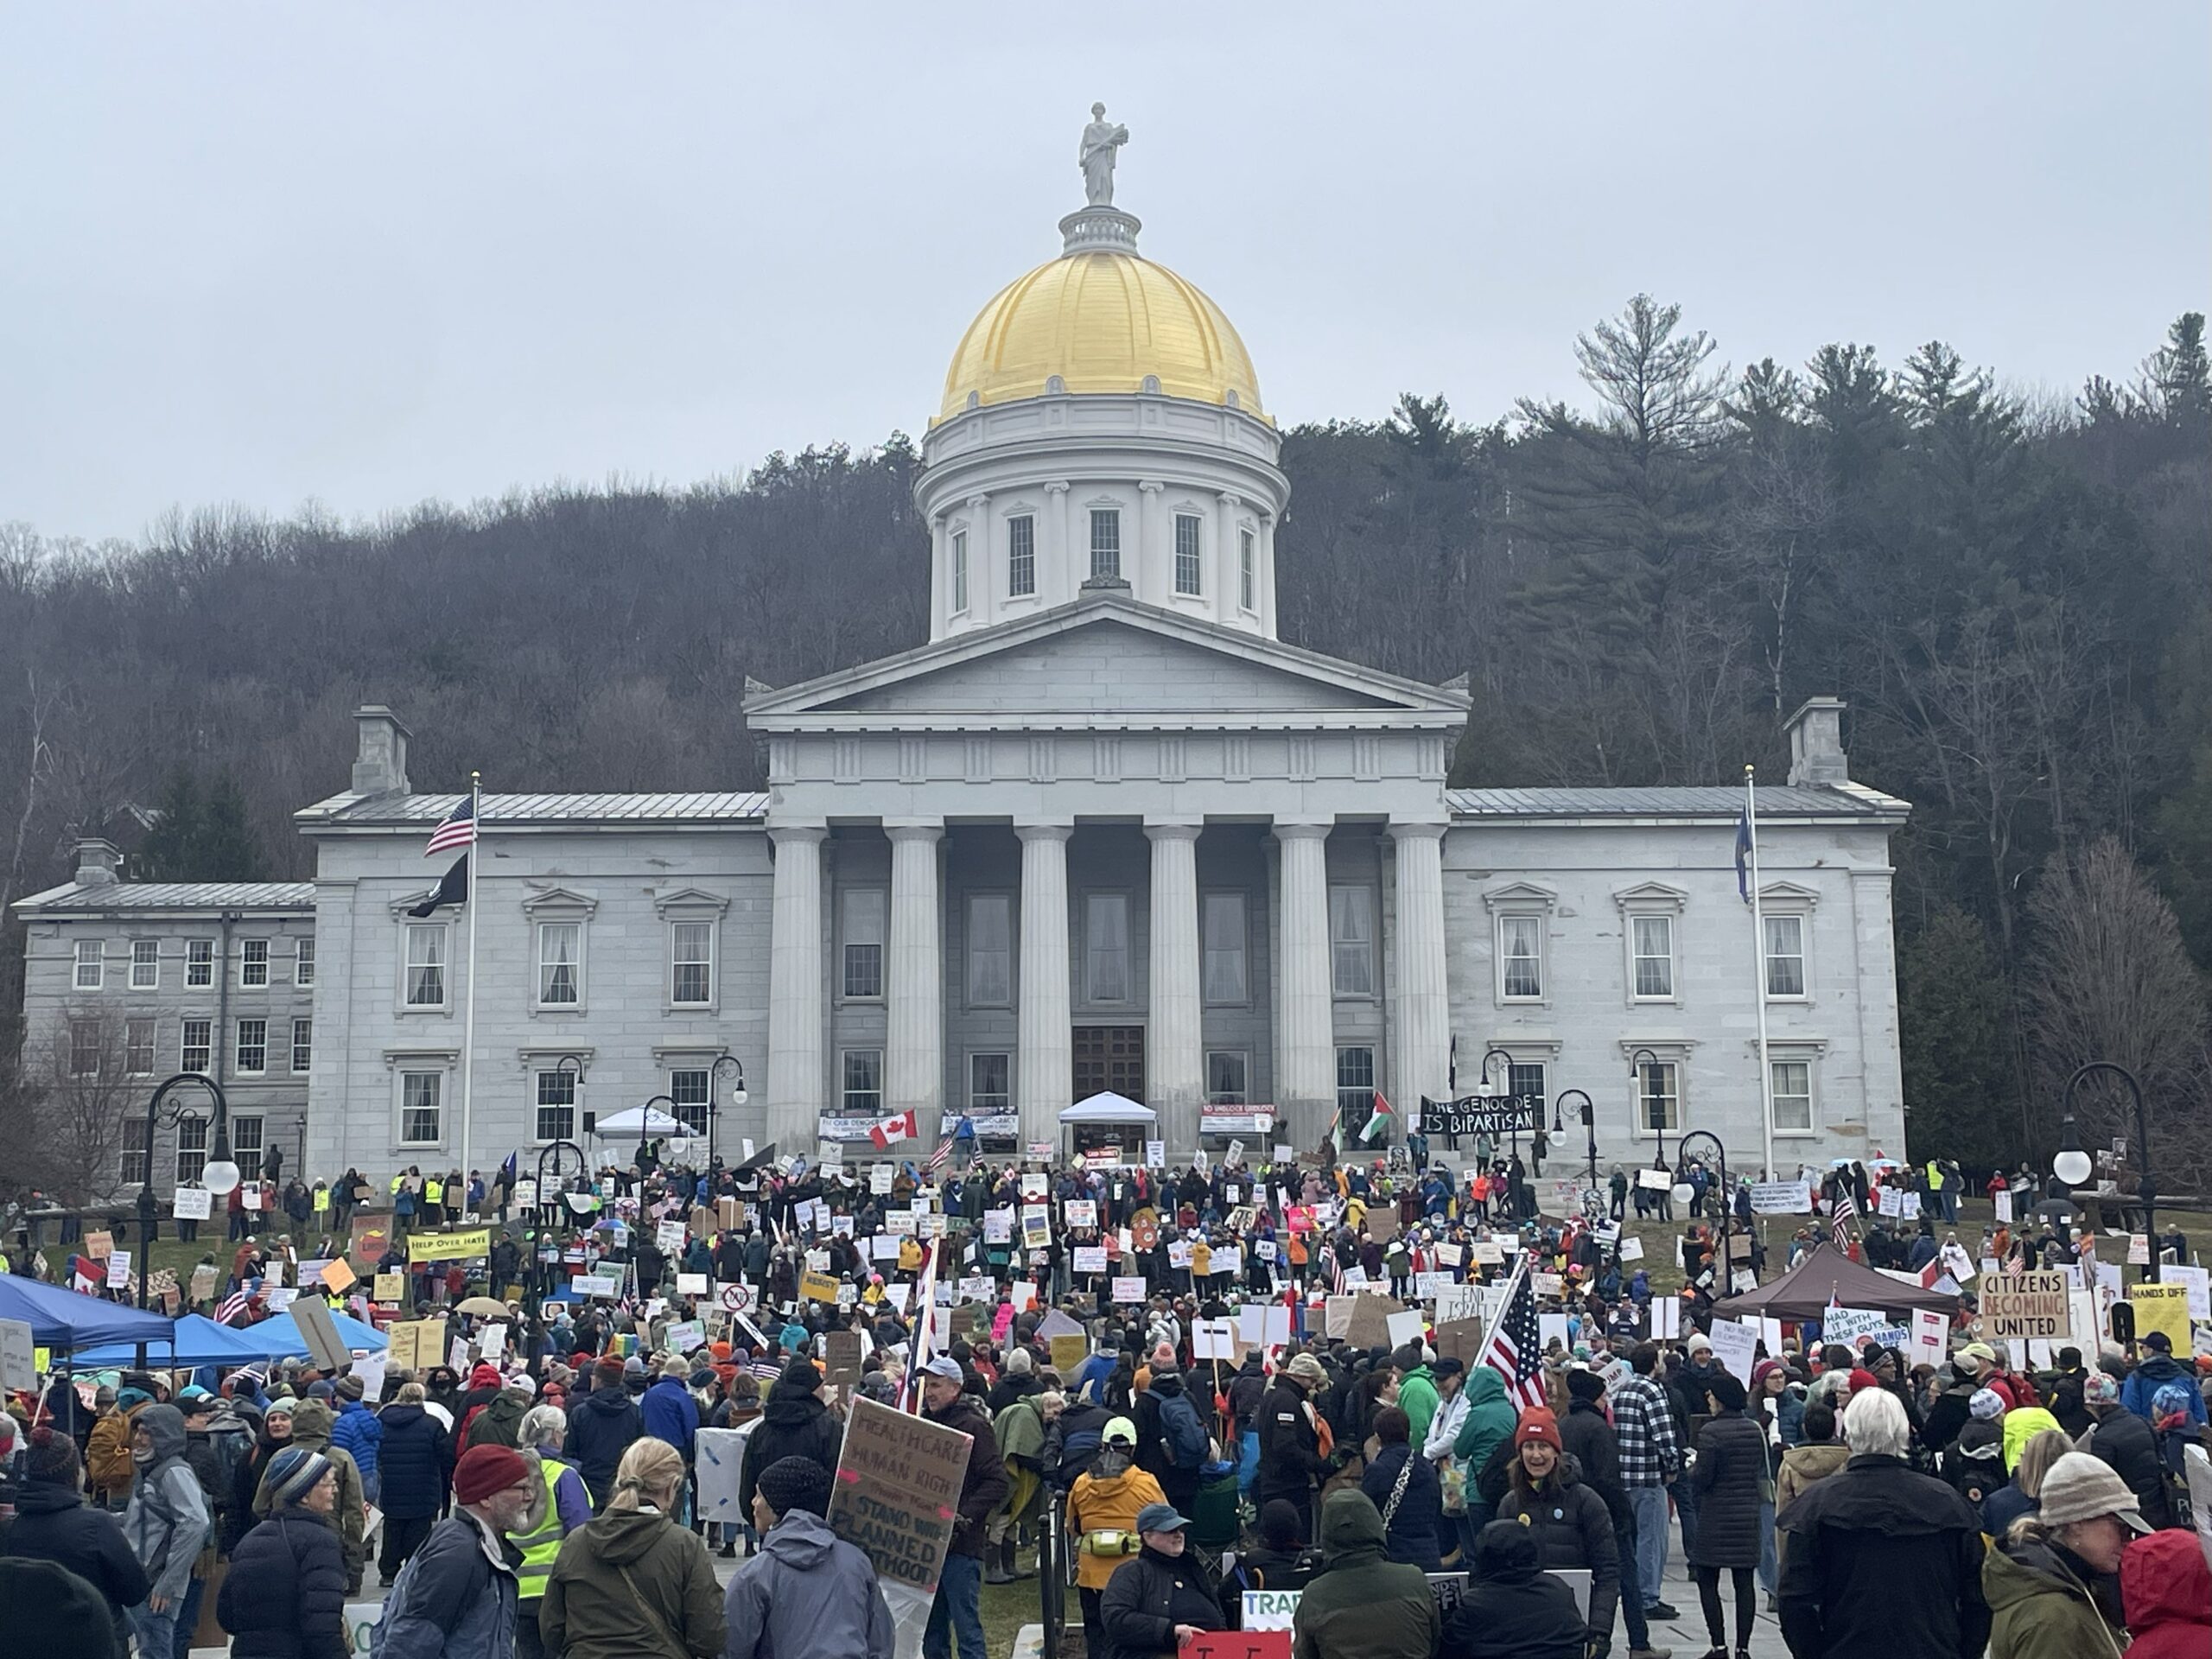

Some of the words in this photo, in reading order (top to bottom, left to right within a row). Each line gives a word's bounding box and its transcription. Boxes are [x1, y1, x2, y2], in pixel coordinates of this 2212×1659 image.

[1428, 1102, 1455, 1114] THE
[1459, 1094, 1532, 1114] GENOCDE
[1424, 1114, 1444, 1131] IS
[411, 1240, 434, 1249] HELP
[436, 1239, 461, 1248] OVER
[464, 1236, 486, 1245] HATE
[1986, 1274, 2062, 1294] CITIZENS
[2133, 1288, 2164, 1299] HANDS
[2167, 1287, 2189, 1298] OFF
[1984, 1294, 2064, 1316] BECOMING
[1825, 1310, 1849, 1323] HAD
[1832, 1323, 1841, 1332] IT
[1845, 1313, 1872, 1329] WITH
[1824, 1330, 1854, 1343] THESE
[1857, 1319, 1885, 1333] GUYS
[1873, 1329, 1908, 1343] HANDS
[1994, 1318, 2056, 1336] UNITED
[857, 1413, 964, 1464] HEALTHCARE
[851, 1445, 911, 1481] HUMAN
[859, 1496, 911, 1529] STAND
[833, 1508, 937, 1565] PLANNED
